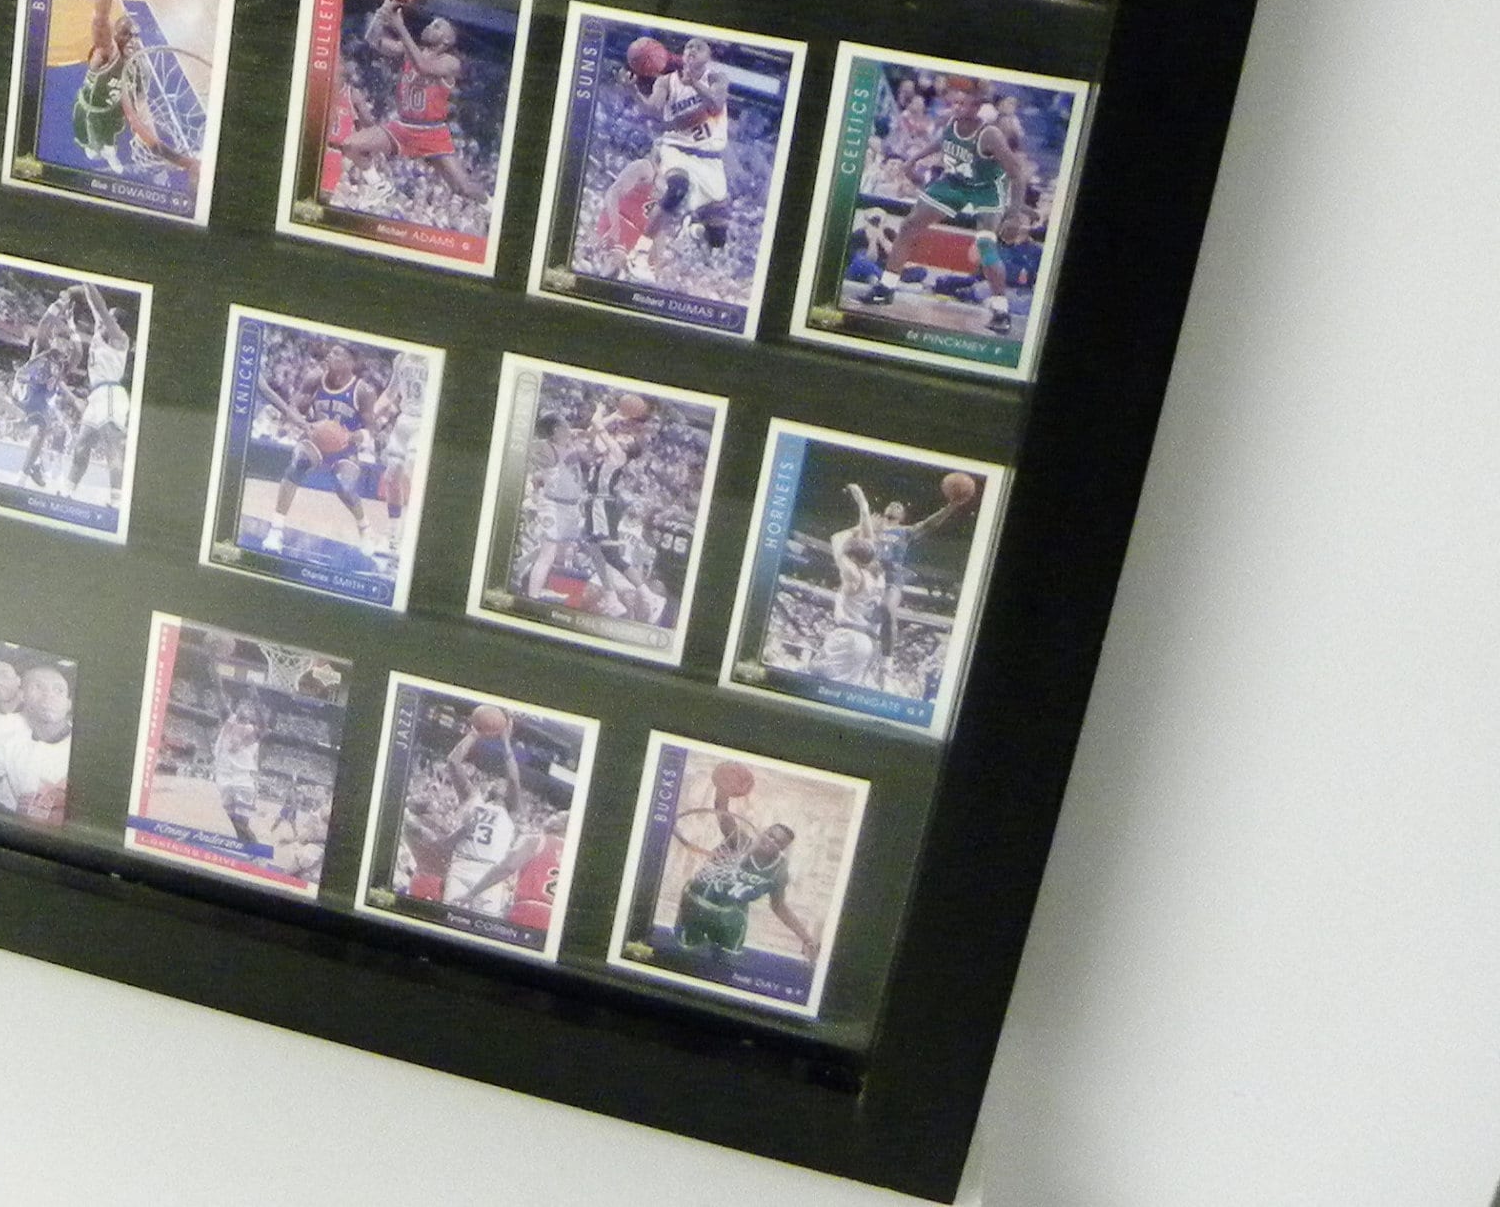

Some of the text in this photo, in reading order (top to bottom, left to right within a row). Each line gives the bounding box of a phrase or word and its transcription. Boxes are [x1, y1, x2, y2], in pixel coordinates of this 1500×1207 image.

[576, 45, 598, 100] SUNS
[840, 88, 869, 174] CELTICS
[110, 182, 168, 205] EDWARDS
[411, 231, 457, 249] ADAMS
[664, 297, 715, 319] DUMAS
[234, 344, 256, 415] KNICKS
[764, 461, 794, 550] HORNETS
[395, 706, 414, 751] JAZZ
[653, 768, 677, 822] BUCKS
[191, 832, 245, 850] Anderson
